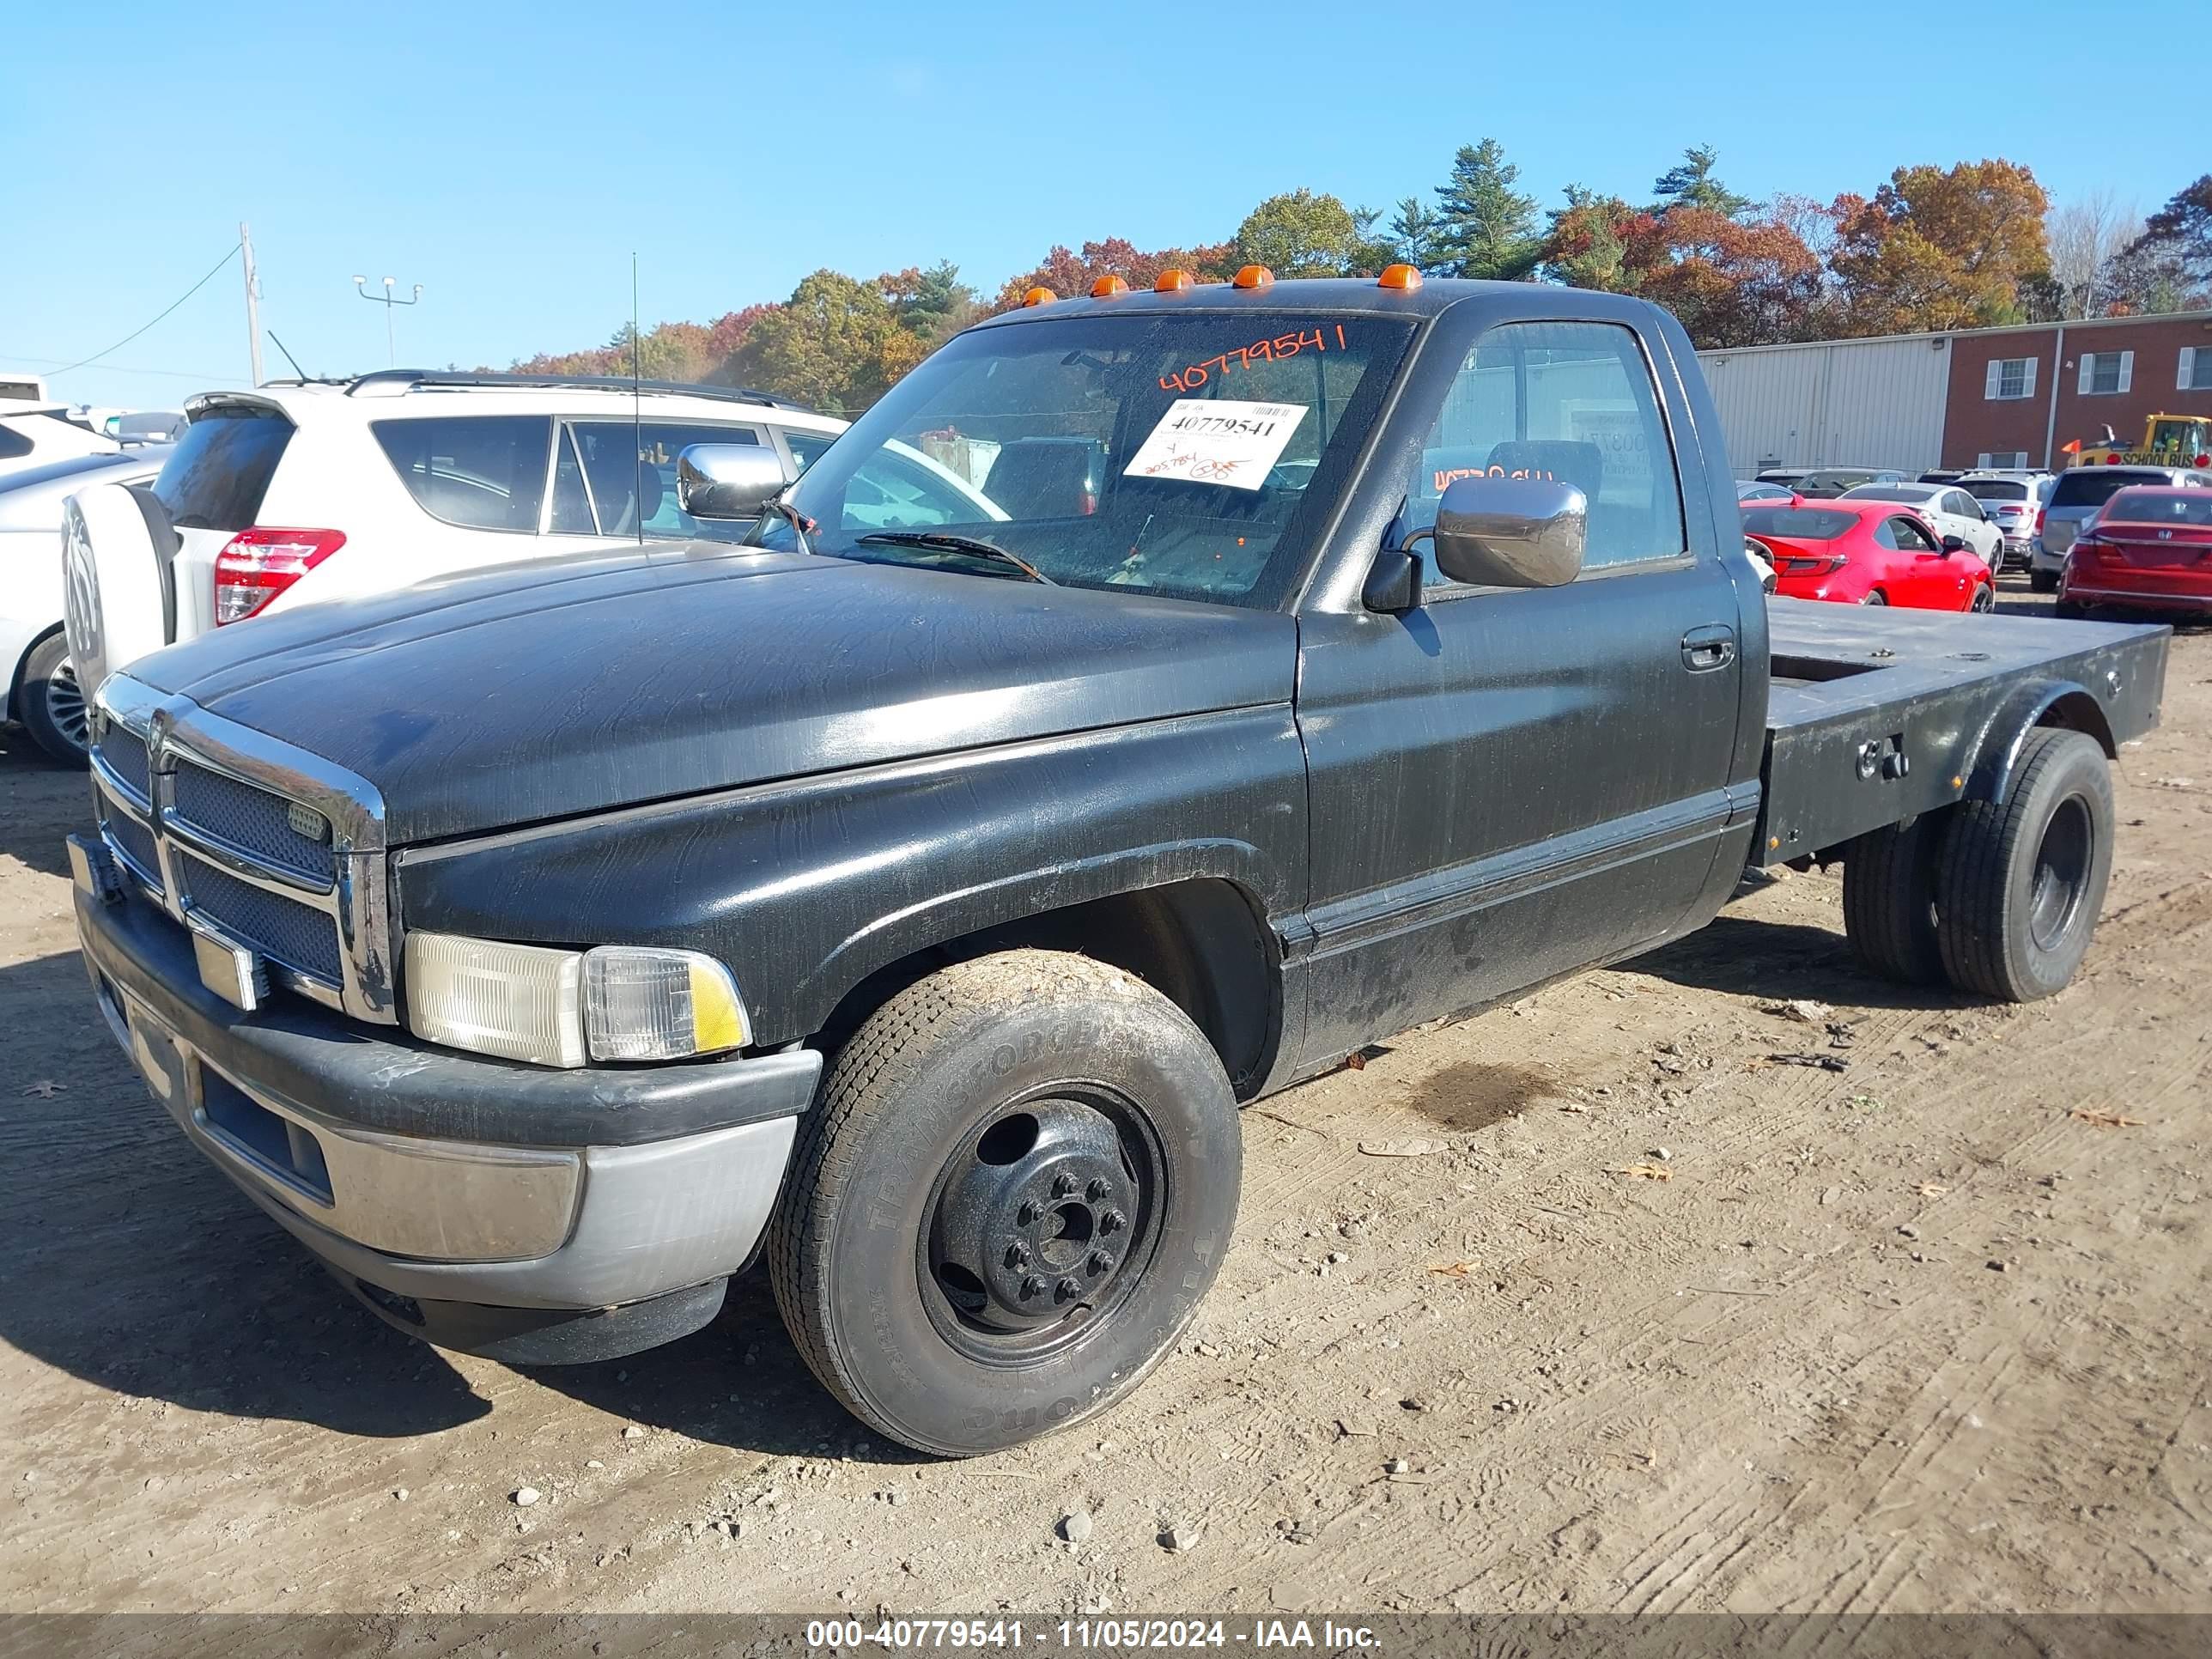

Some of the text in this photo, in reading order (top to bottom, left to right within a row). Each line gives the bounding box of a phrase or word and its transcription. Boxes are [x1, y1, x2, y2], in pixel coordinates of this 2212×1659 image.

[1159, 325, 1346, 392] 40779541
[1171, 416, 1276, 436] 40779541
[2122, 453, 2194, 468] SCHOOL BUS
[867, 1018, 1095, 1234] TRANSFORCE
